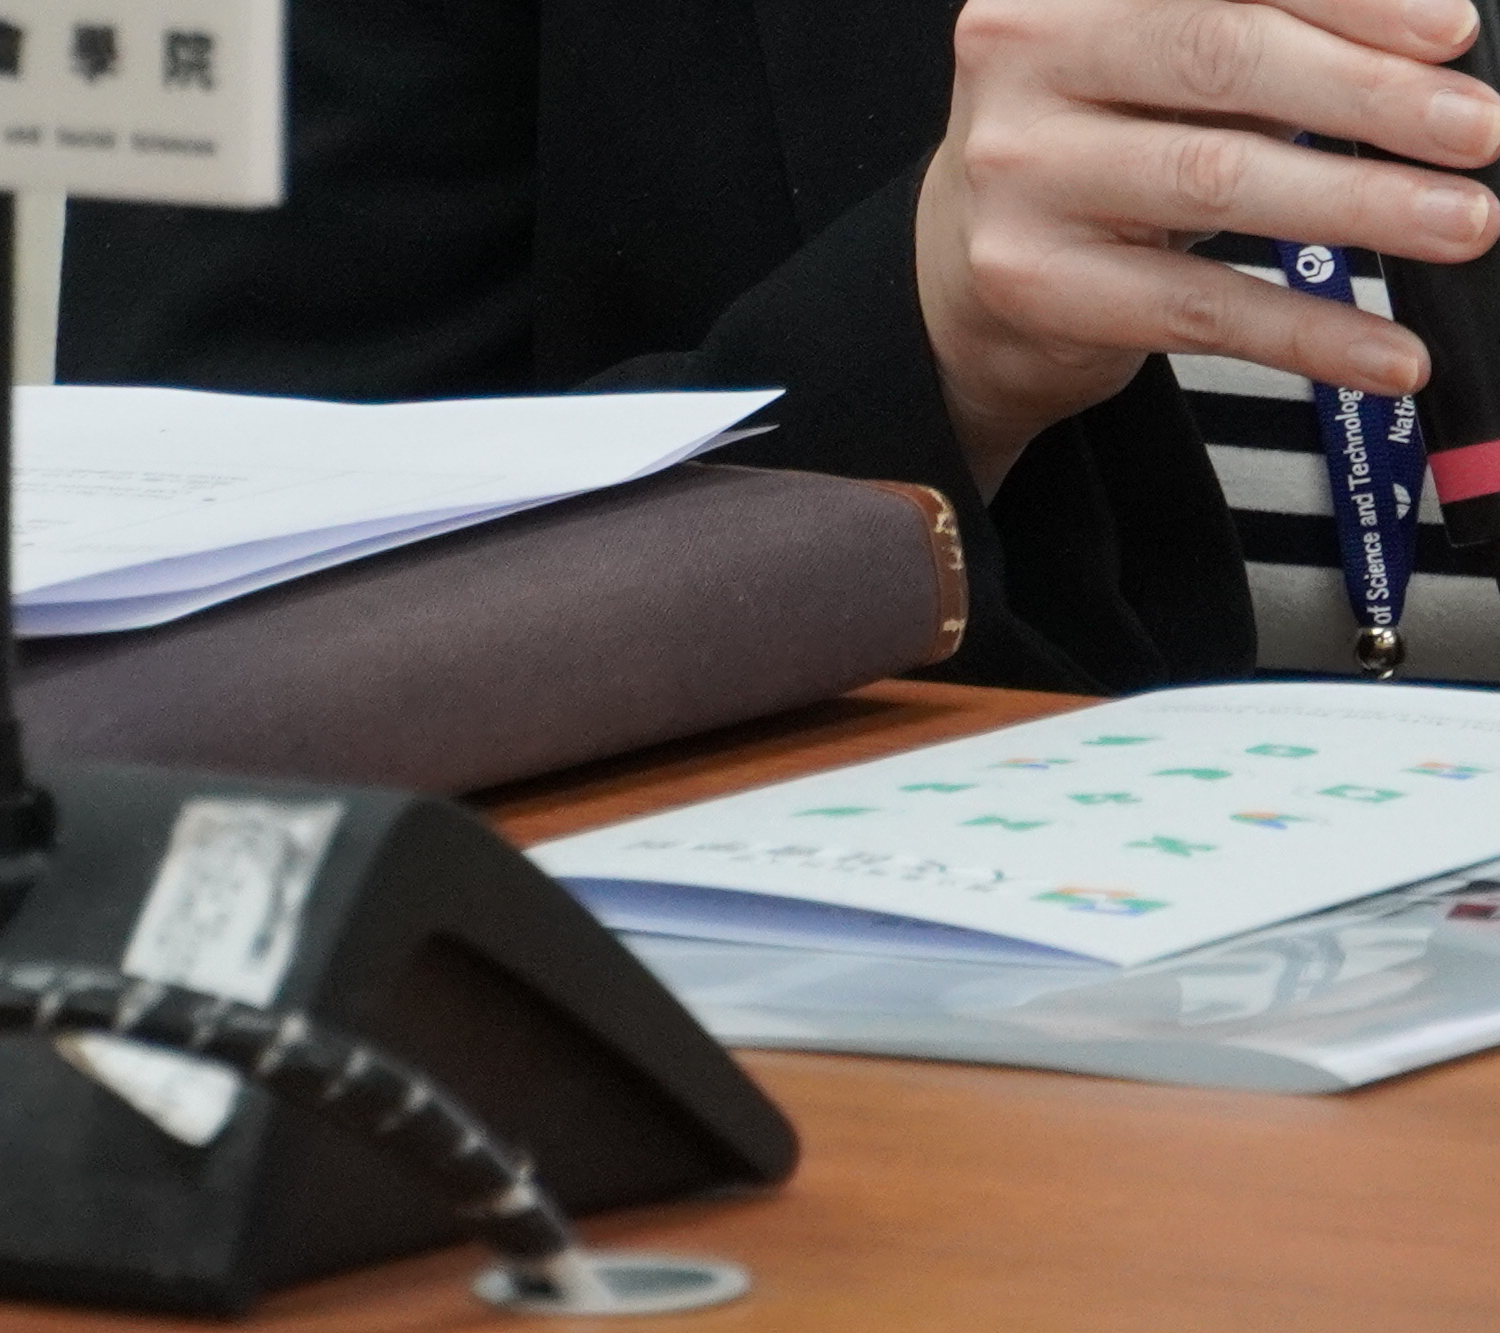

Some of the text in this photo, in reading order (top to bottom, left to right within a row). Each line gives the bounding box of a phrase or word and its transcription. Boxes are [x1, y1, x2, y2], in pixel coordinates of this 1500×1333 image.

[1351, 493, 1379, 527] and
[1363, 531, 1390, 605] Science
[1366, 604, 1392, 625] of
